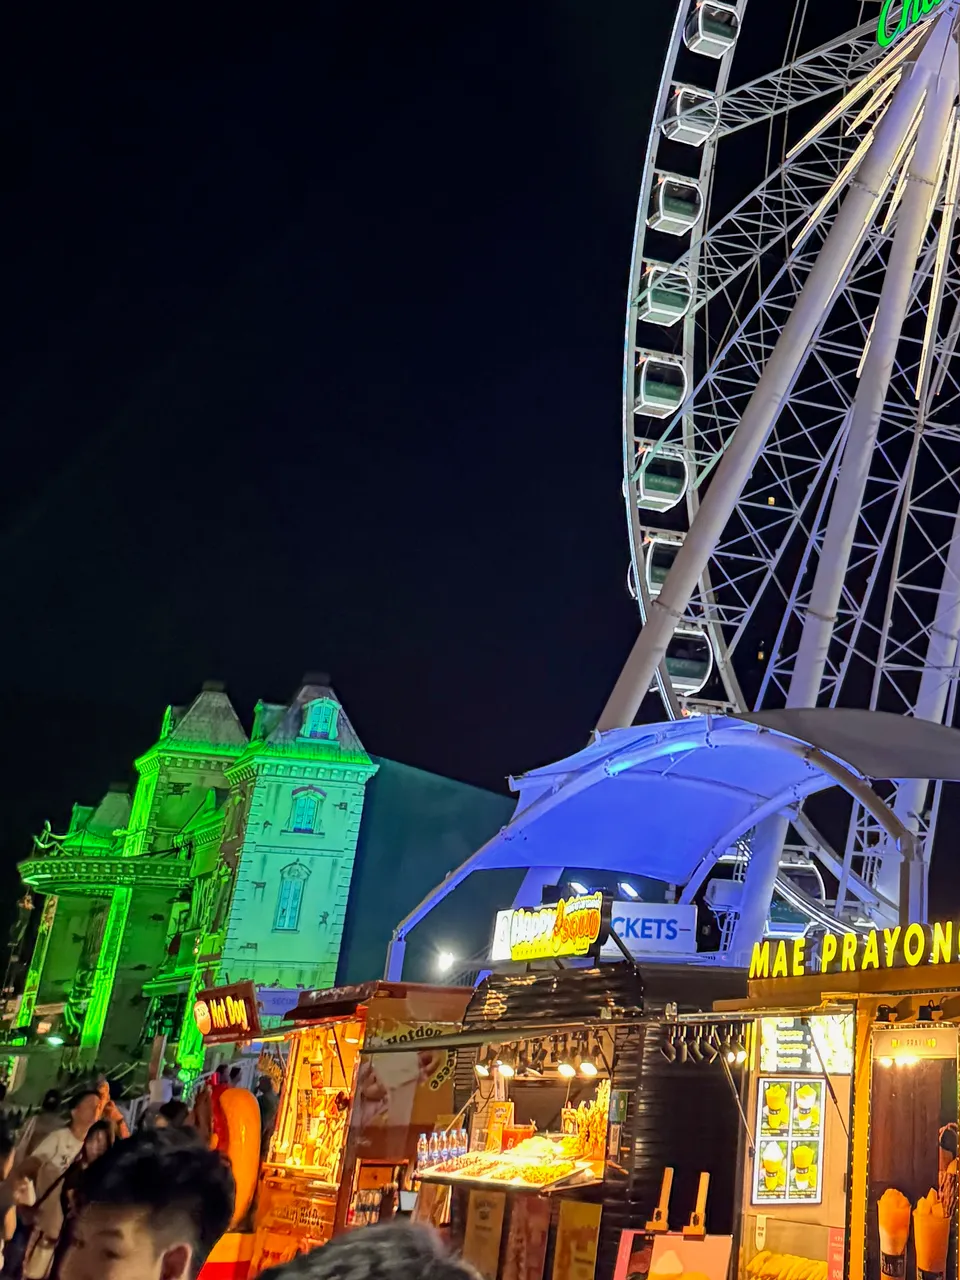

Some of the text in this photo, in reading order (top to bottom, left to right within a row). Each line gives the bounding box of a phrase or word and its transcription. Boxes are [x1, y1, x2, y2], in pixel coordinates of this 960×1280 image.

[749, 937, 806, 979] MAE
[210, 995, 248, 1030] Hot Dog
